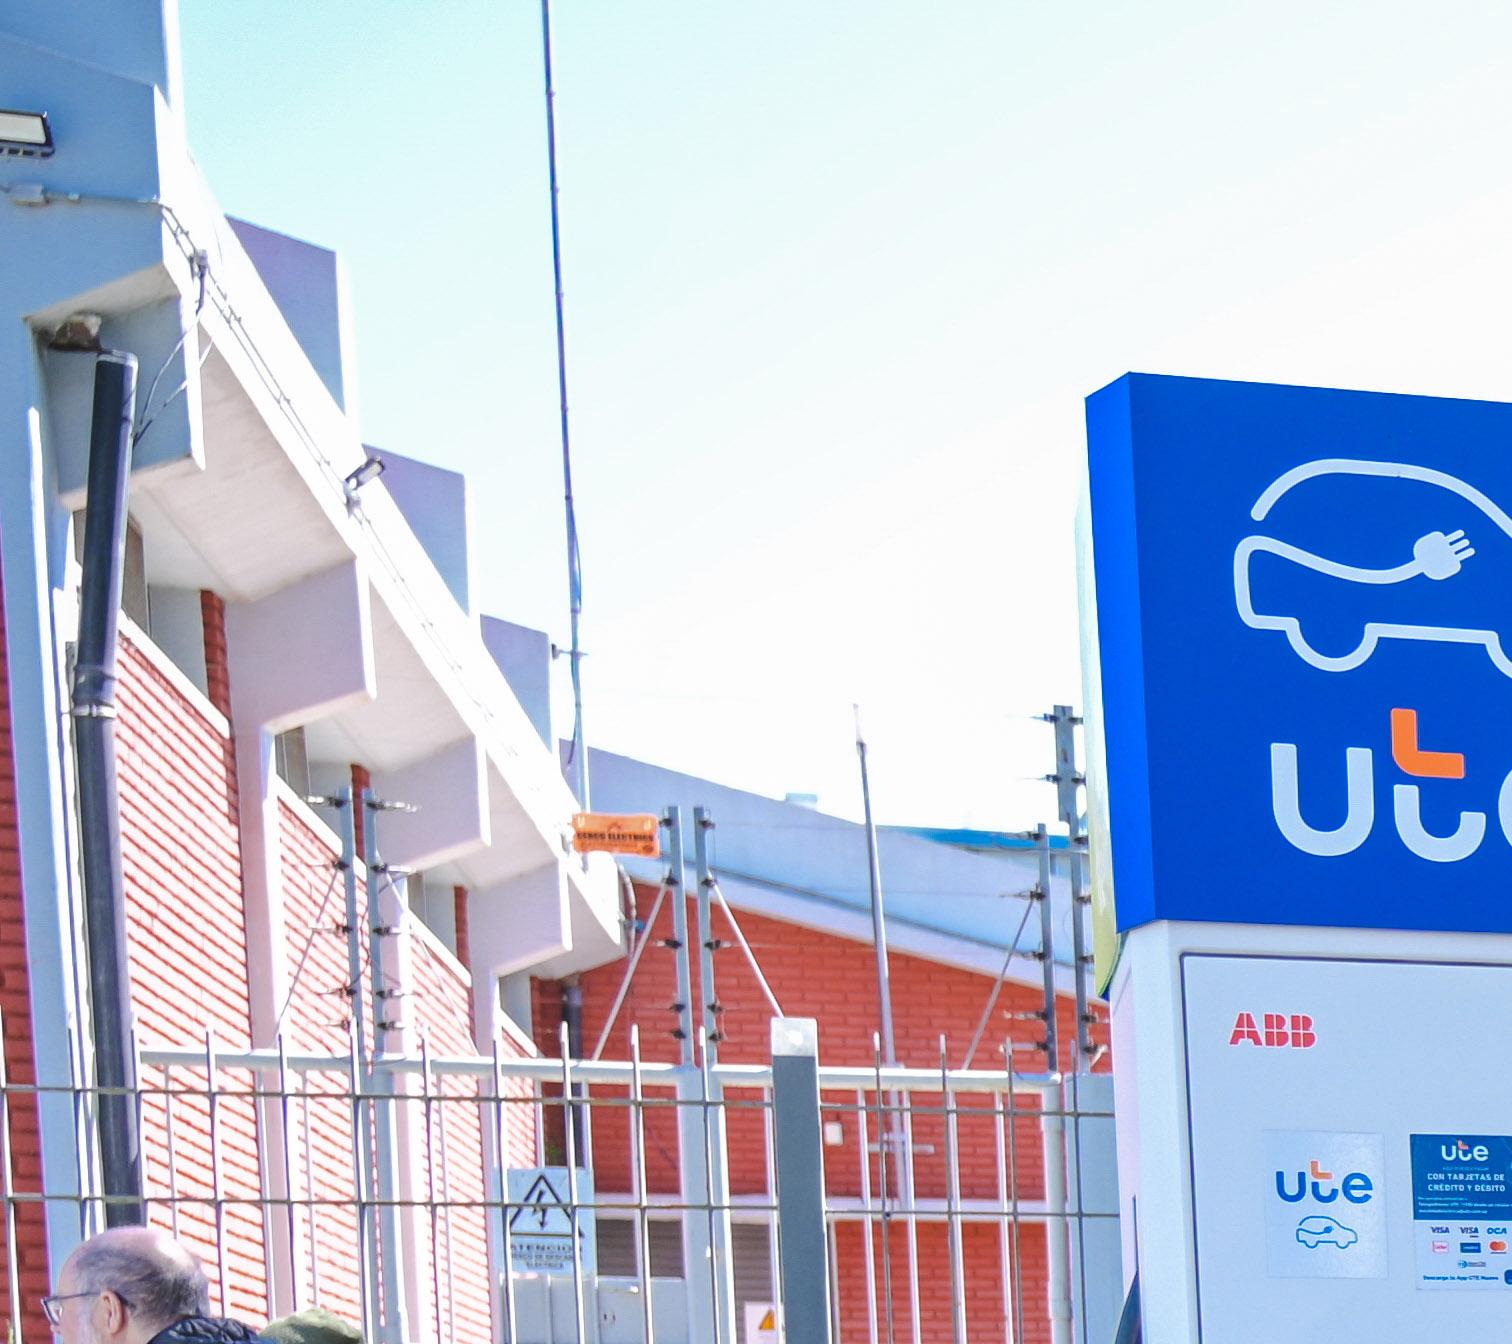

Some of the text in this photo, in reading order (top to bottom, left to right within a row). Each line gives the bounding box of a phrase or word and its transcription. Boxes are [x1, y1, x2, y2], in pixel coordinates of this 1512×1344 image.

[1229, 1012, 1316, 1048] ABB
[1427, 1173, 1505, 1181] CON TARJETAS DE
[1430, 1226, 1450, 1234] VISA
[1459, 1226, 1479, 1234] VISA
[1486, 1227, 1507, 1235] OCA
